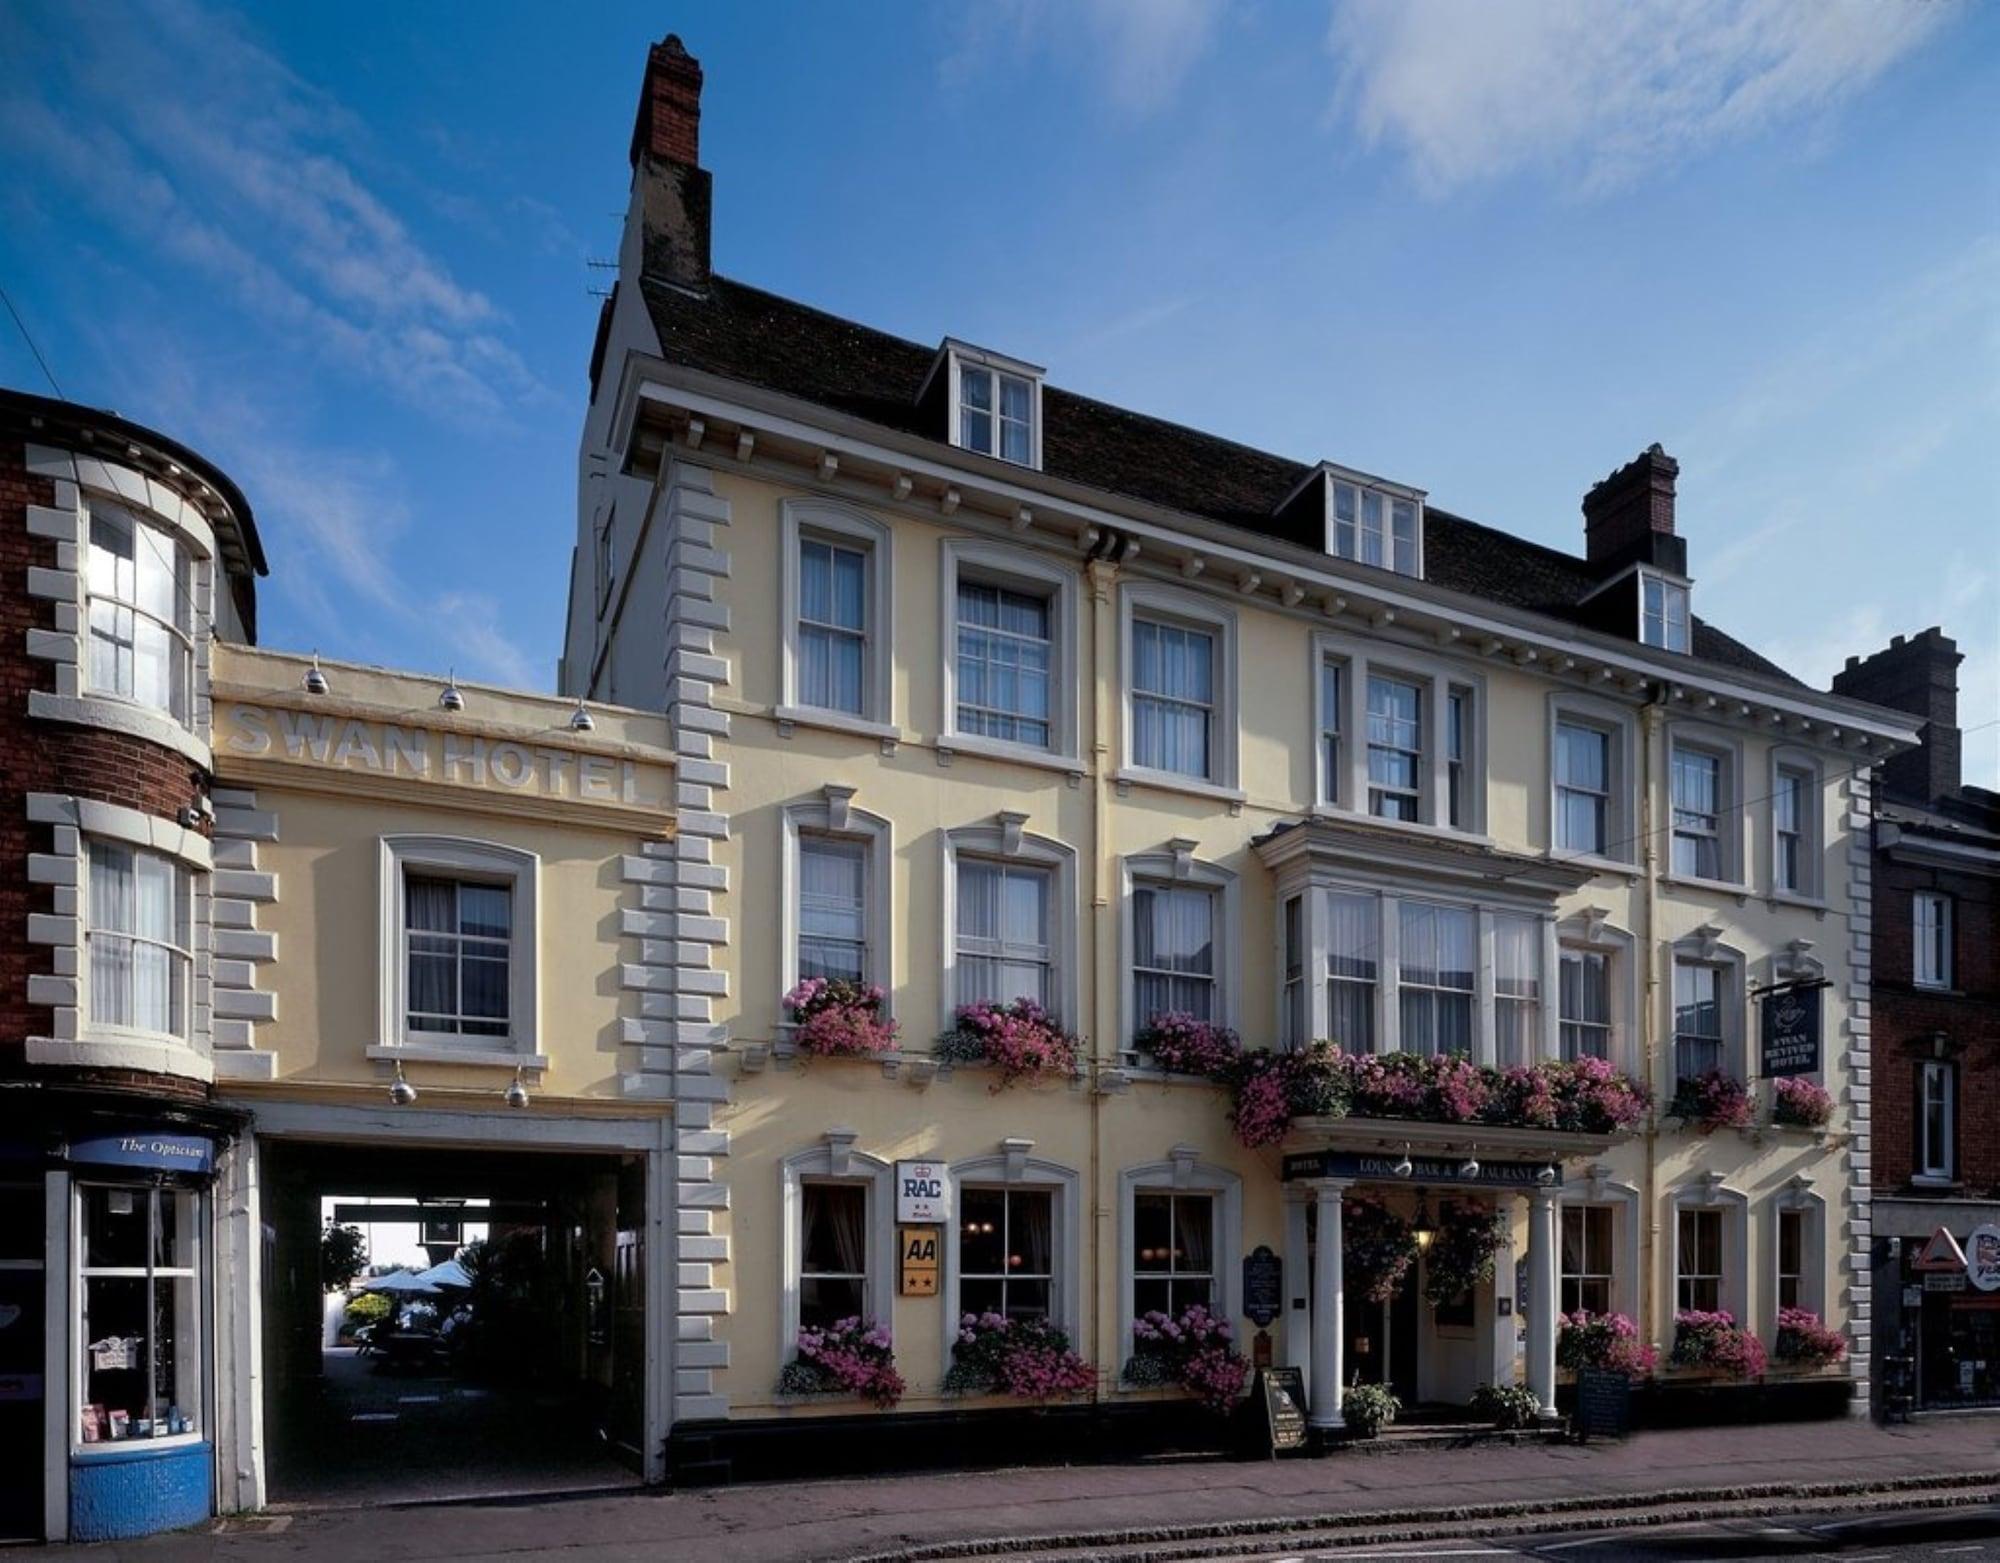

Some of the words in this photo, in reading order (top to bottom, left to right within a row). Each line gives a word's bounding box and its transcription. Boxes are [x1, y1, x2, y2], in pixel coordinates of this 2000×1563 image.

[227, 704, 432, 778] SWAN
[443, 732, 655, 805] HOTEL
[1770, 1054, 1811, 1068] HOTEL
[119, 1137, 147, 1152] The
[1415, 1162, 1440, 1177] BAR
[903, 1179, 941, 1198] RAC
[906, 1239, 936, 1260] AA
